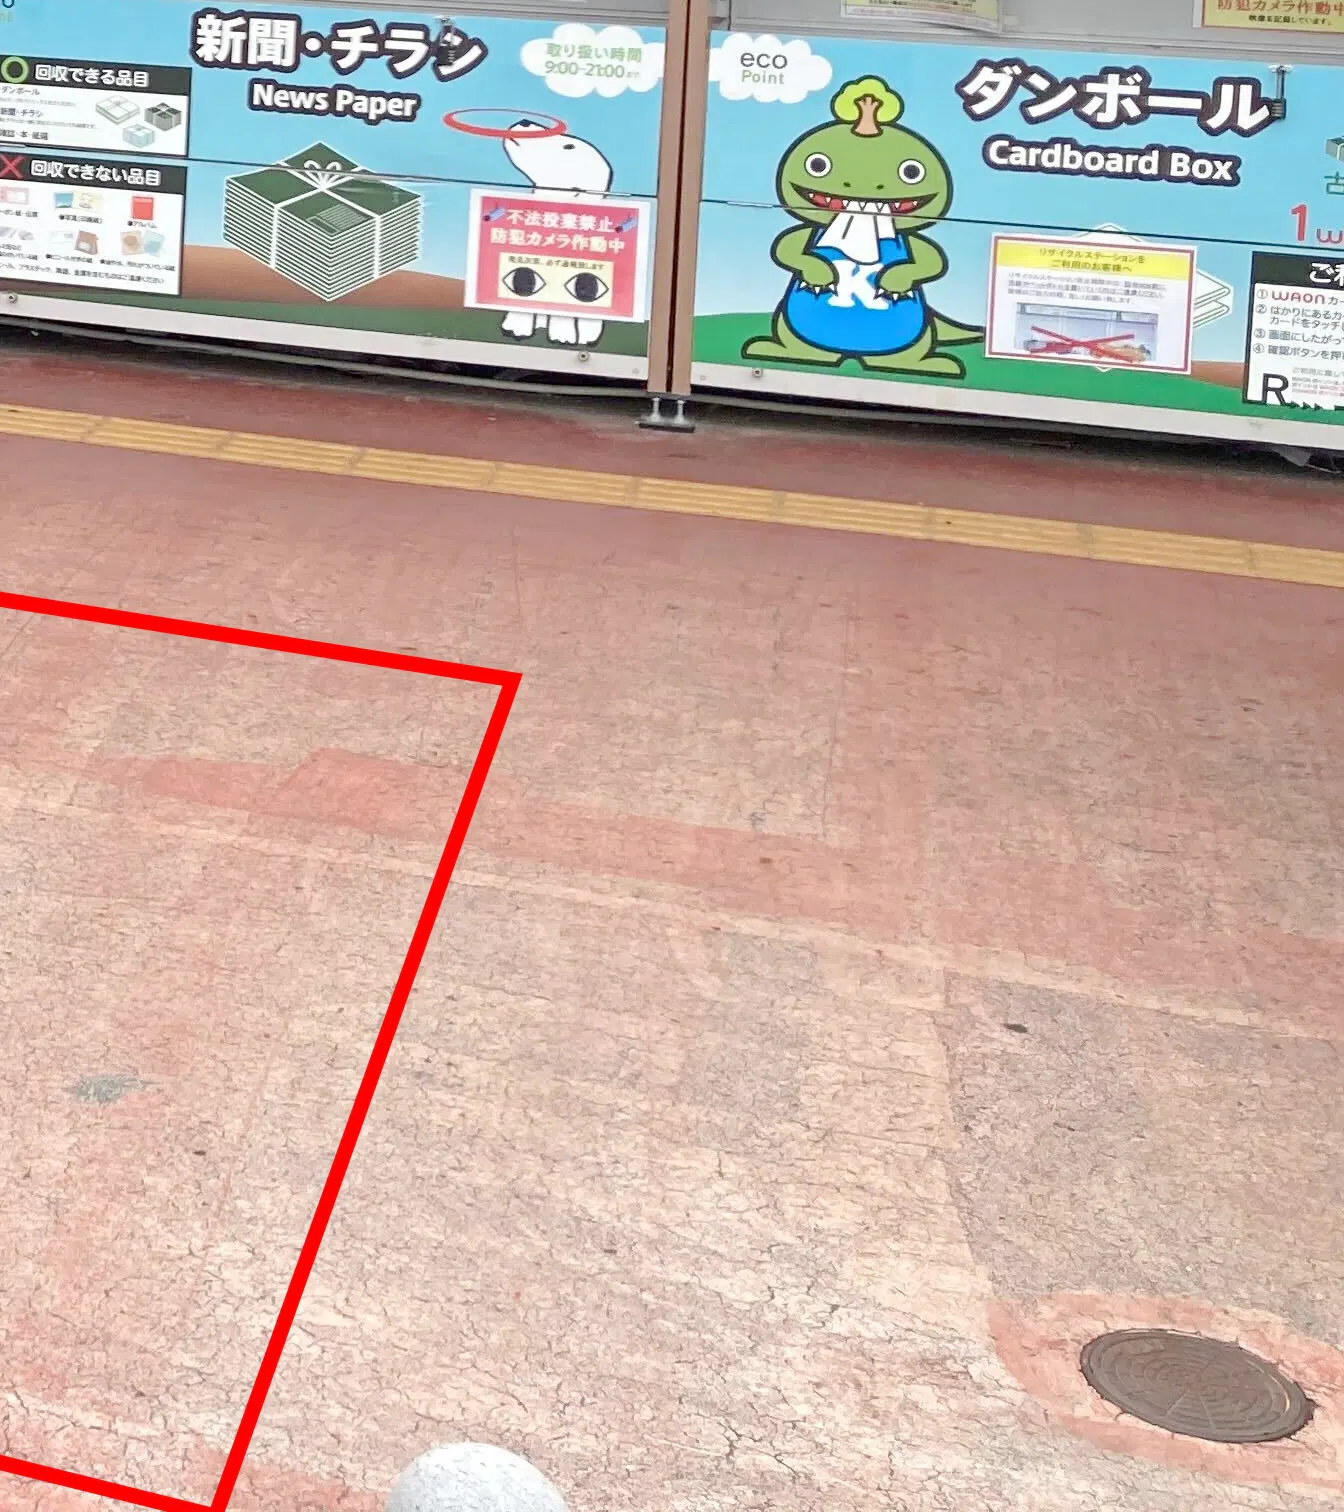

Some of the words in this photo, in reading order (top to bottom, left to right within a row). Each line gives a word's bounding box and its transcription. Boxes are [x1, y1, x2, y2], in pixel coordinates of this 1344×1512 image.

[545, 42, 643, 64] 取り扱い時間
[740, 50, 788, 69] eco
[35, 64, 150, 88] 回収できる品目
[741, 68, 785, 85] Point
[253, 83, 329, 112] News
[336, 89, 416, 120] Paper
[963, 62, 1272, 131] ダンボール
[30, 159, 161, 186] 回収できない品目
[988, 139, 1160, 176] Cardboard
[1170, 150, 1235, 181] Box
[506, 208, 614, 233] 不法投棄禁止
[490, 227, 625, 254] 防犯カメラ作動中
